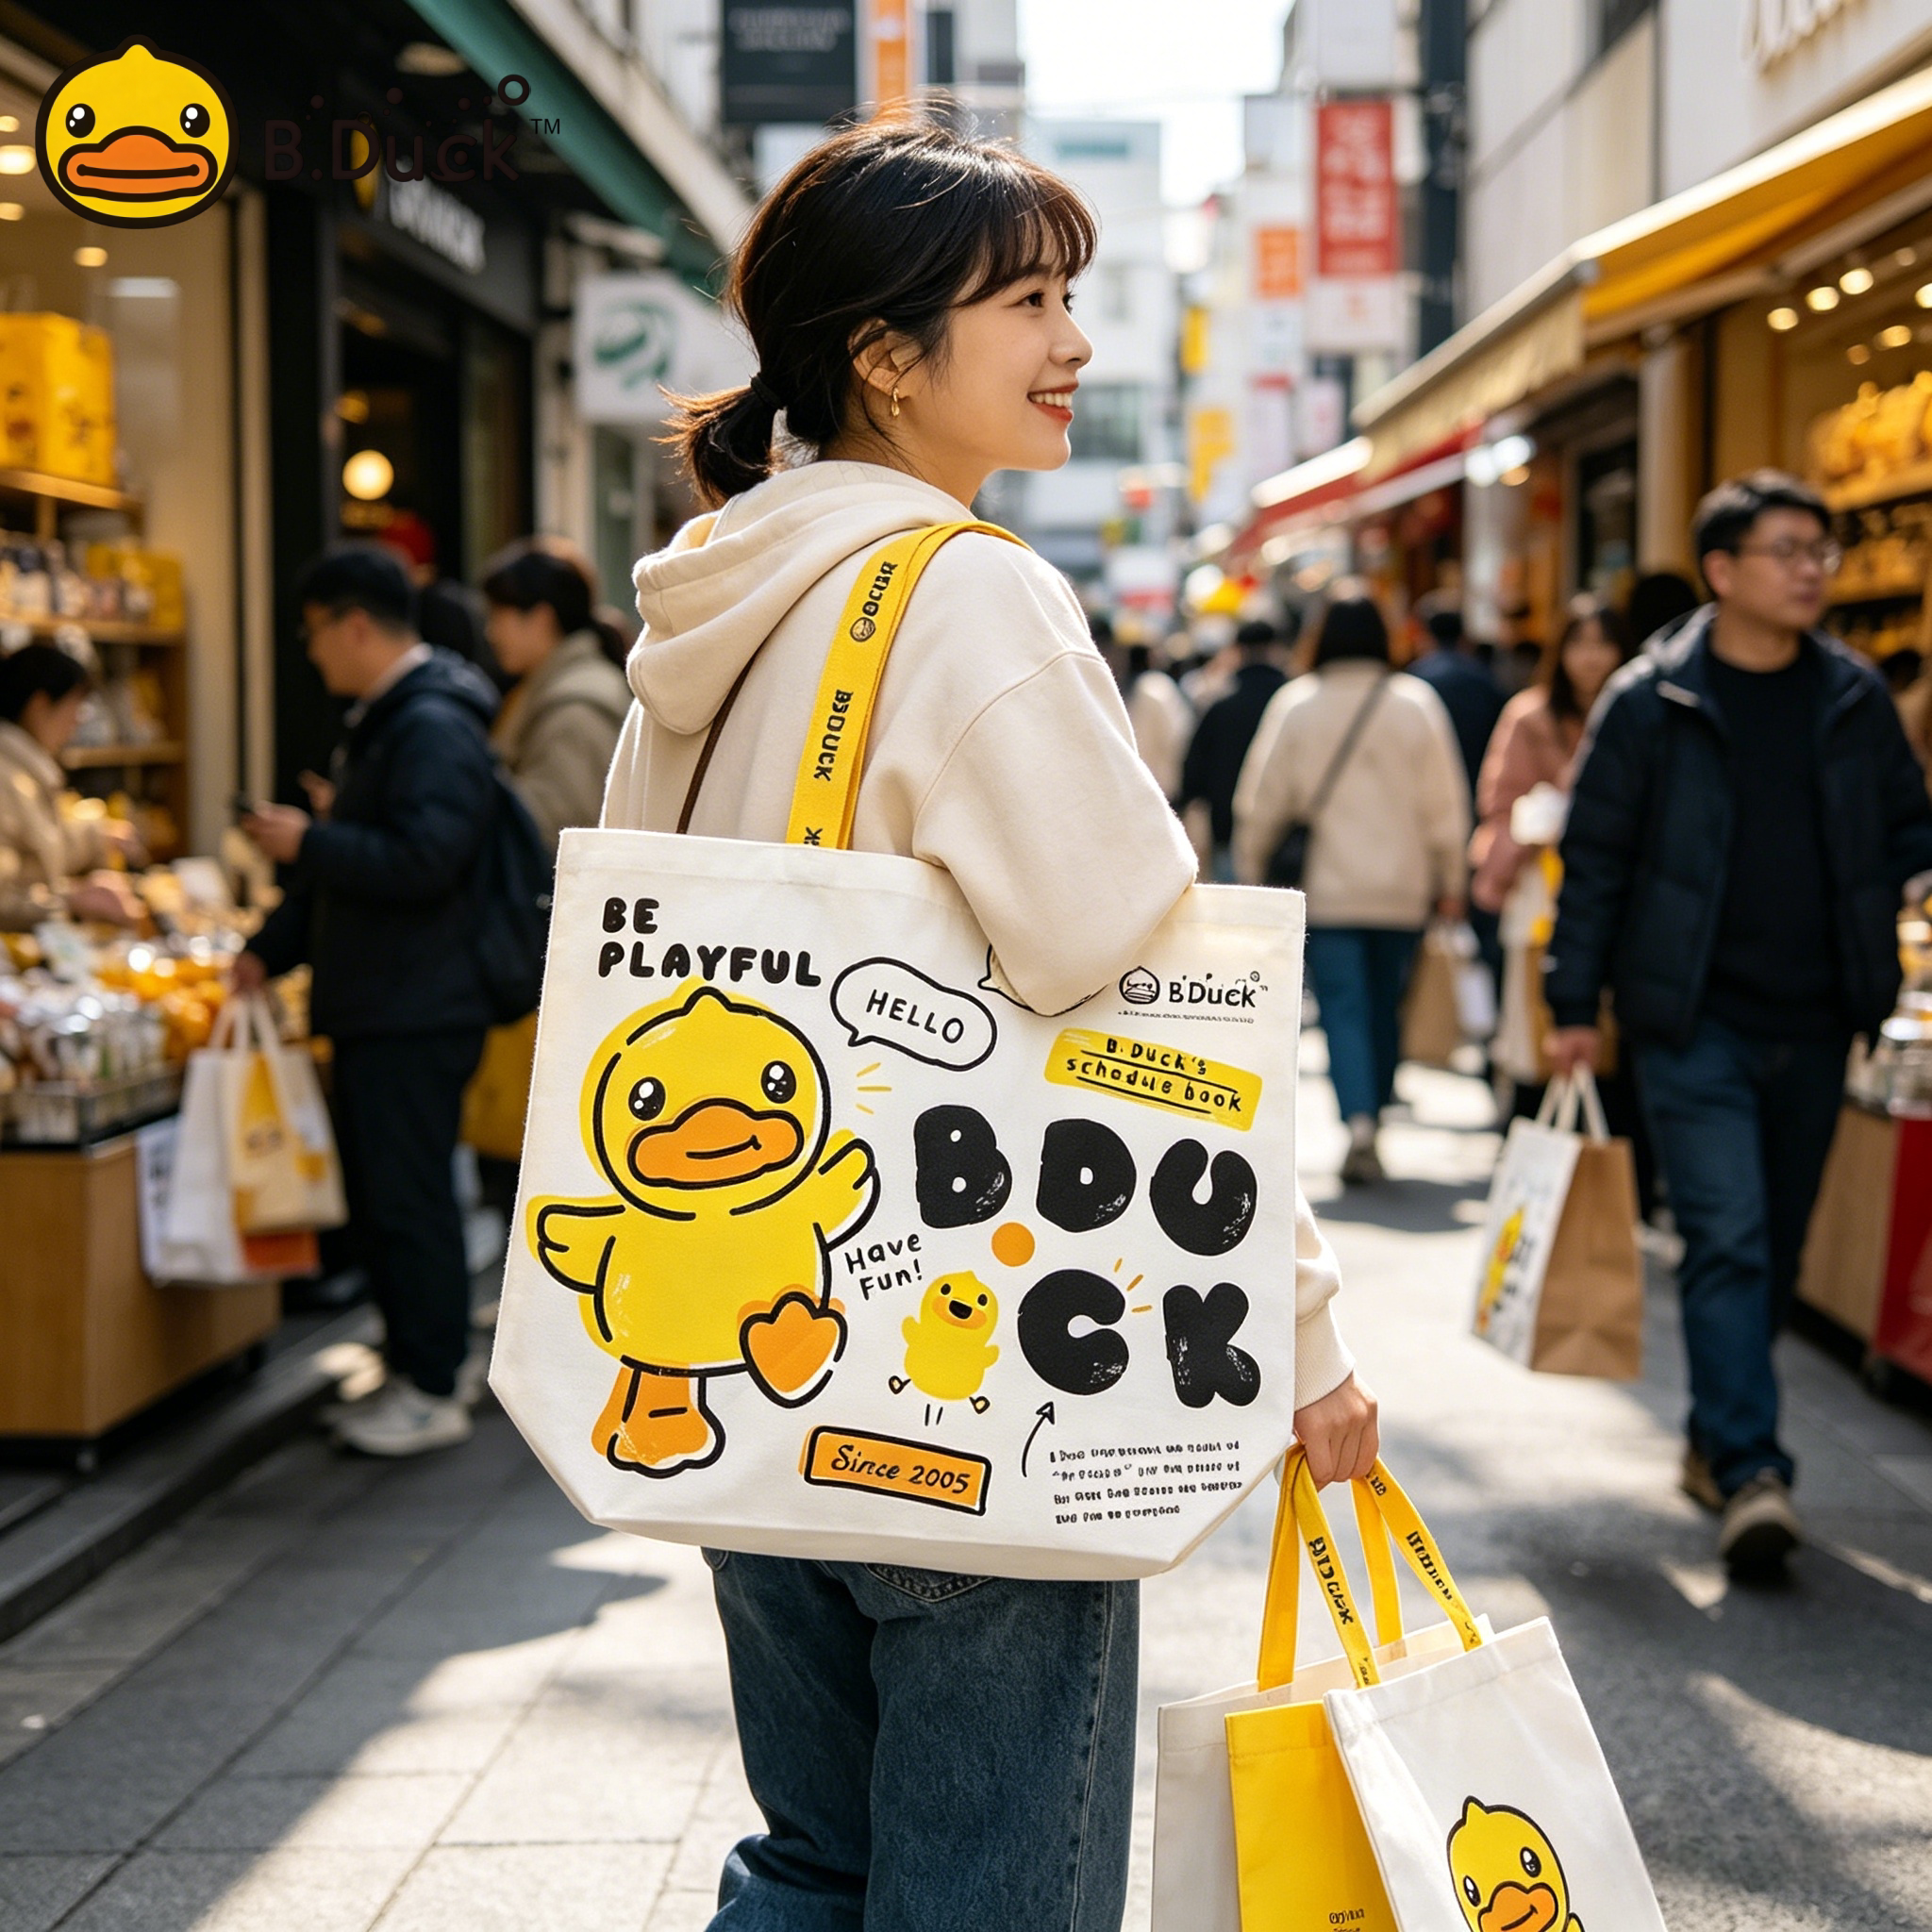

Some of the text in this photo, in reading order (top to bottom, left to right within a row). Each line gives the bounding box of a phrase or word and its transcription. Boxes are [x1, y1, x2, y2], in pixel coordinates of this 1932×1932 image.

[603, 897, 659, 934] BE
[598, 941, 822, 987] PLAYFUL
[866, 989, 964, 1042] HELLO
[1185, 1081, 1241, 1112] book
[845, 1234, 922, 1274] Have
[859, 1258, 923, 1301] Fun!
[831, 1444, 971, 1494] Since 2005
